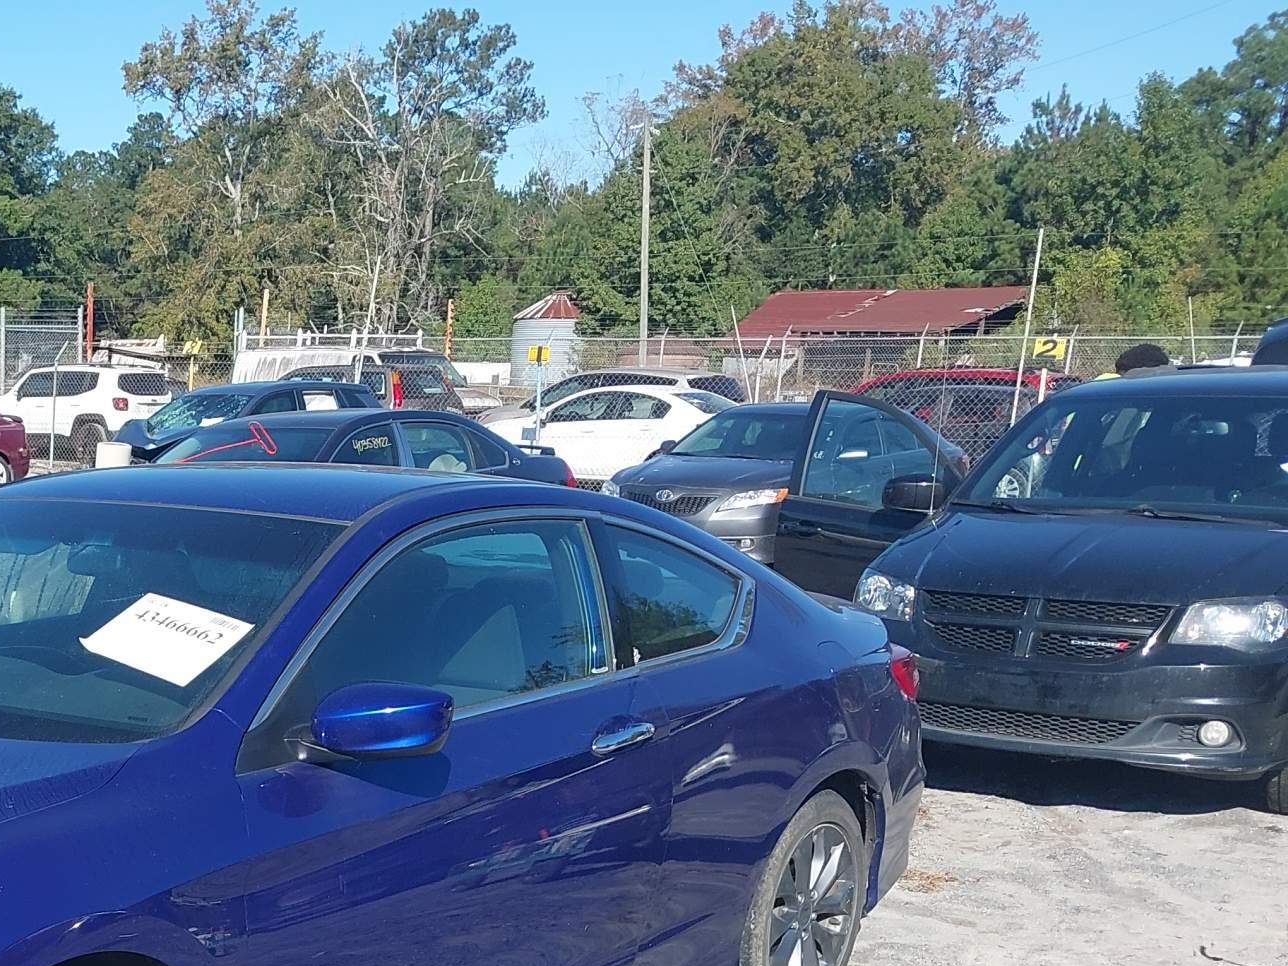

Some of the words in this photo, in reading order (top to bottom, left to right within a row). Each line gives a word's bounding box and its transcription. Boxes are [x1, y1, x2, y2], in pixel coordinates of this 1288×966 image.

[1035, 339, 1057, 358] 2
[135, 609, 224, 645] 43466662
[1071, 640, 1117, 648] DODGE
